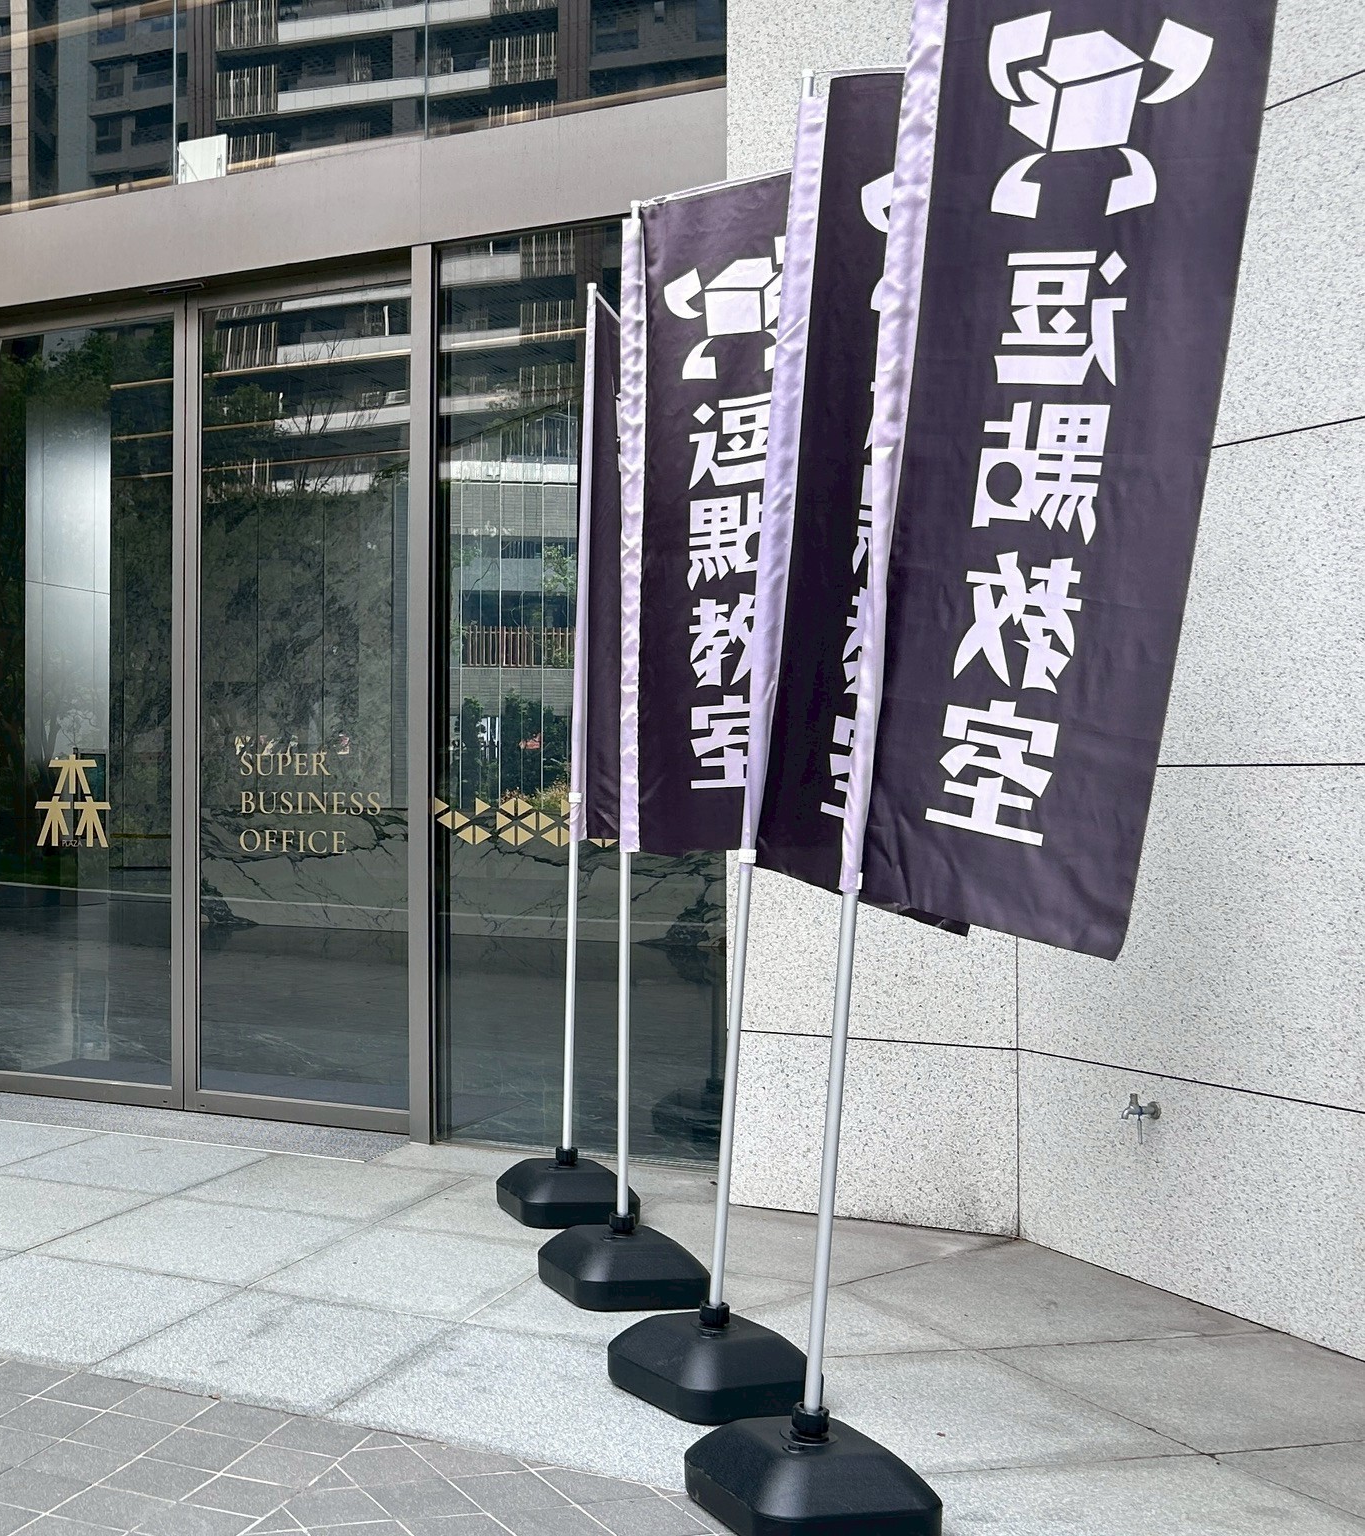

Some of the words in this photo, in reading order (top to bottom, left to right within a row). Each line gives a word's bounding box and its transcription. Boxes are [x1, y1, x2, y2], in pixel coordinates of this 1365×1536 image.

[687, 391, 772, 789] 逗點教室
[239, 752, 331, 777] SUPER
[239, 791, 382, 816] BUSINESS
[61, 839, 83, 848] PLAZA
[239, 829, 348, 854] OFFICE
